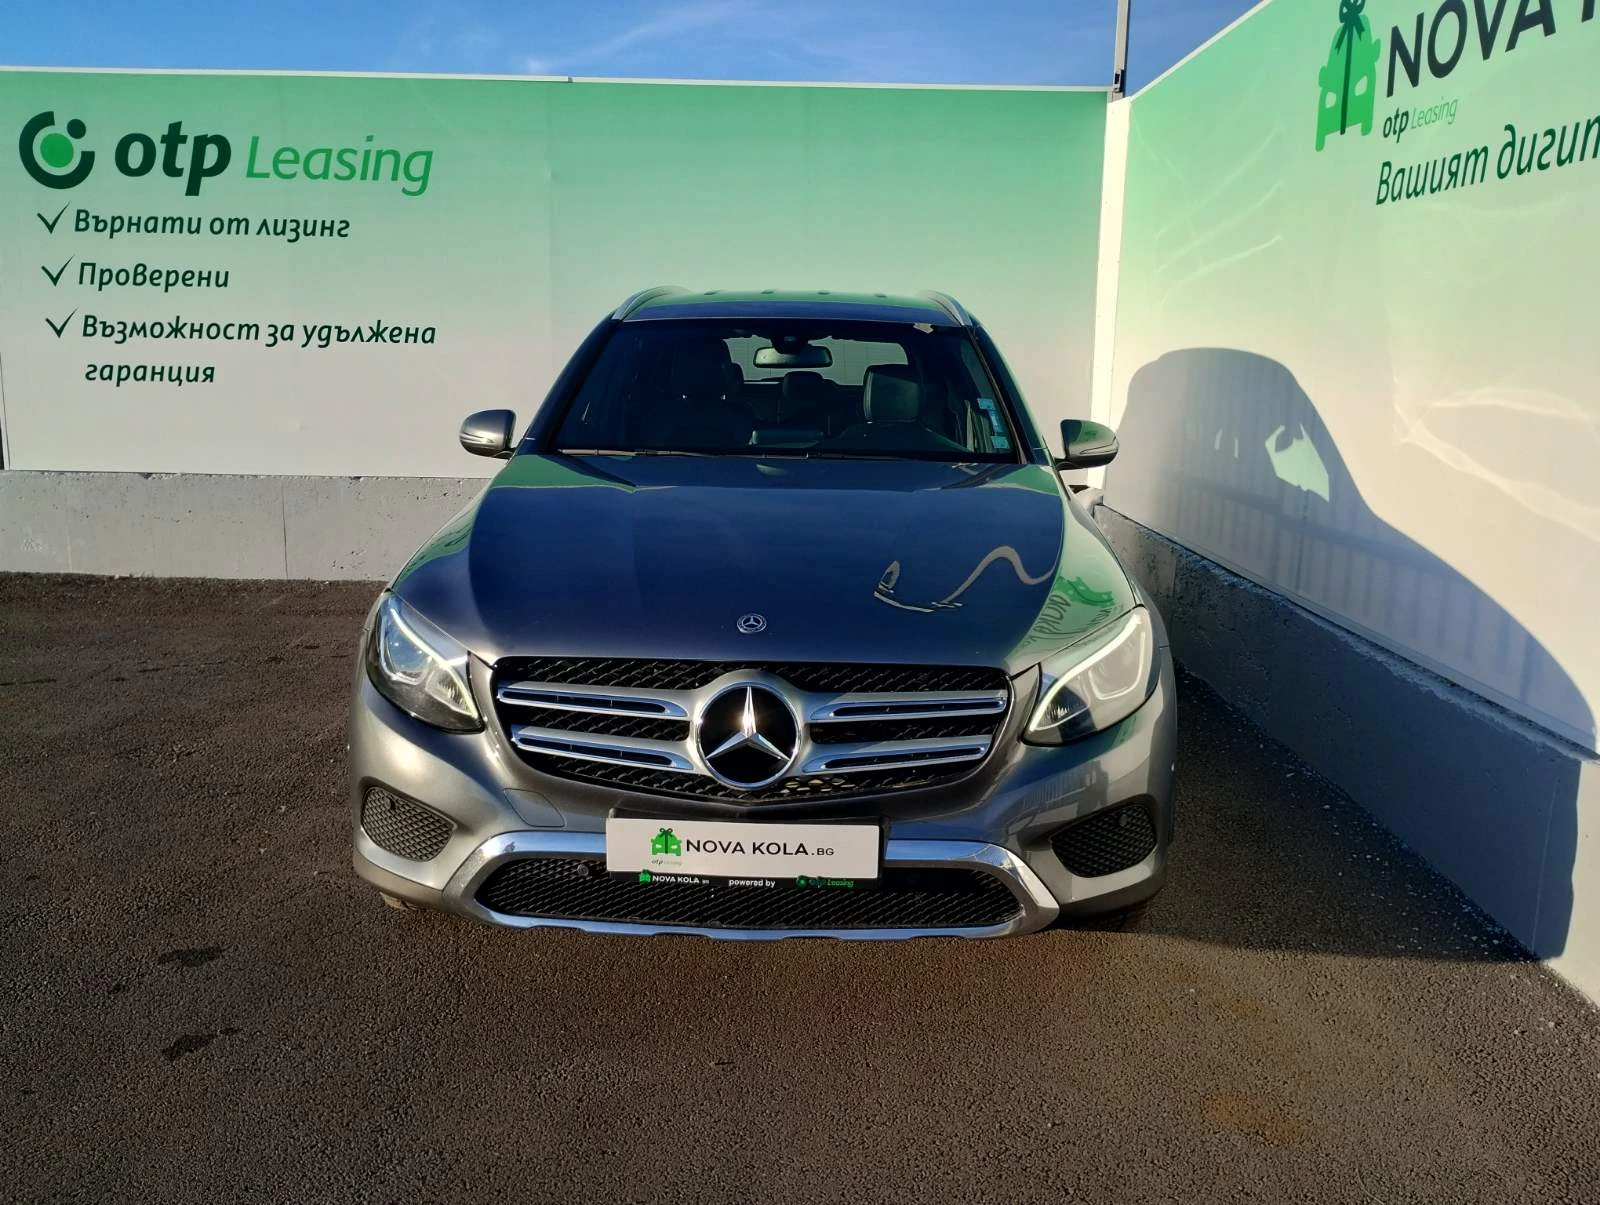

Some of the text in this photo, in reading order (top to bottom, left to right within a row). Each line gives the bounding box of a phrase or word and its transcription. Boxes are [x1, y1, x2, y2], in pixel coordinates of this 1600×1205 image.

[1383, 96, 1458, 144] otp Leasing
[114, 120, 434, 196] otp Leasing
[1376, 145, 1488, 205] Вашият
[74, 209, 351, 242] Върнати от лизинг
[78, 262, 230, 292] Проверени
[82, 315, 437, 348] Възможност за удължена
[84, 361, 216, 387] гаранция
[686, 839, 746, 855] NOVA
[652, 874, 677, 883] NOVA
[677, 876, 700, 884] KOLA
[728, 878, 776, 889] powered by
